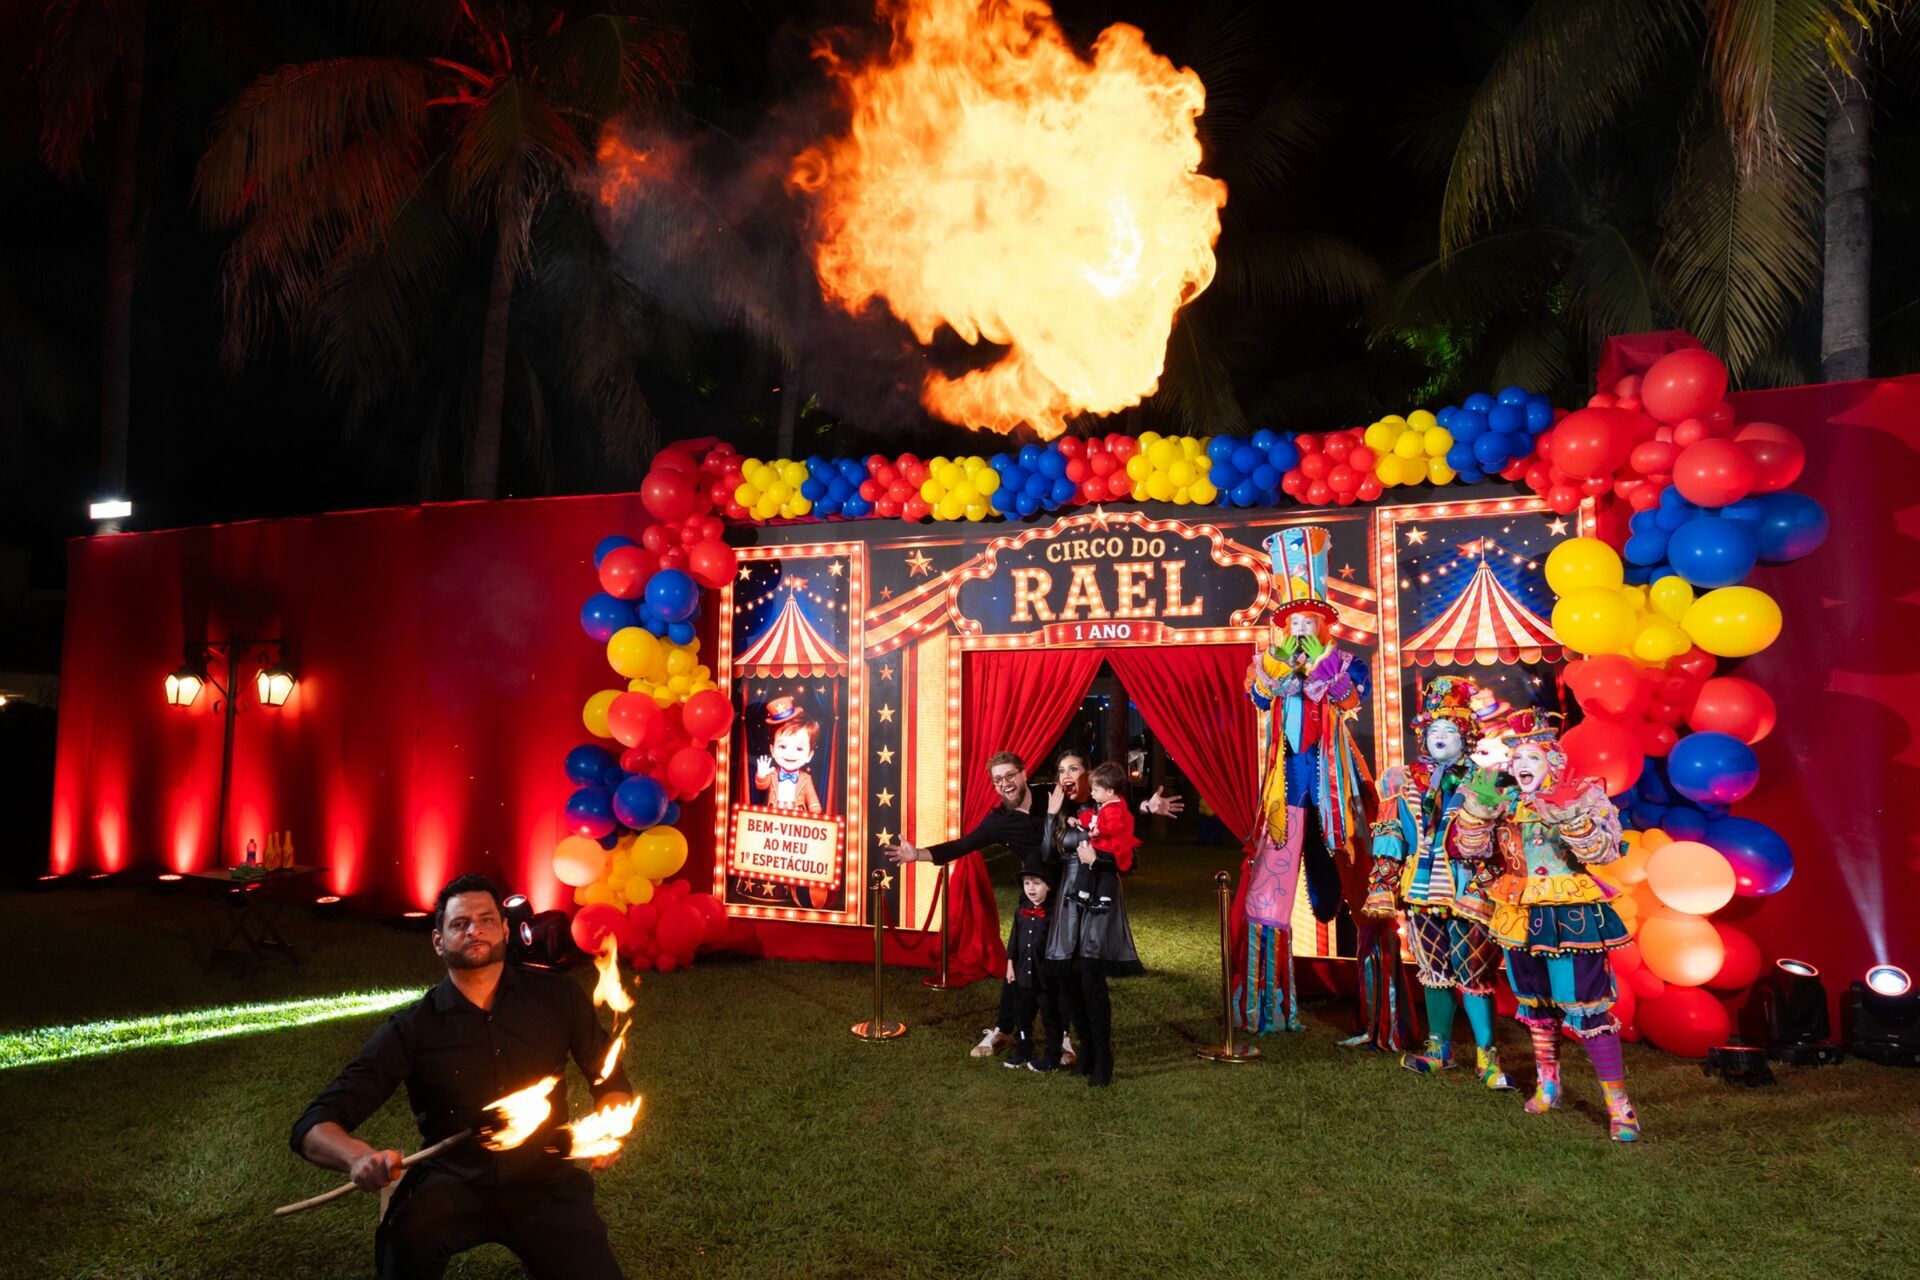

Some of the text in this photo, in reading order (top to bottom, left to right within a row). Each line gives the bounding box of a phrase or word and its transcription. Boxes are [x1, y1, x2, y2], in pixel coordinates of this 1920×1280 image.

[1046, 537, 1166, 563] CIRCO DO
[1010, 560, 1203, 622] RAEL
[1074, 624, 1131, 640] 1 ANO
[747, 819, 827, 840] BEM-VINDOS
[763, 838, 807, 854] AO MEU
[752, 853, 828, 875] ESPETÁCULO!
